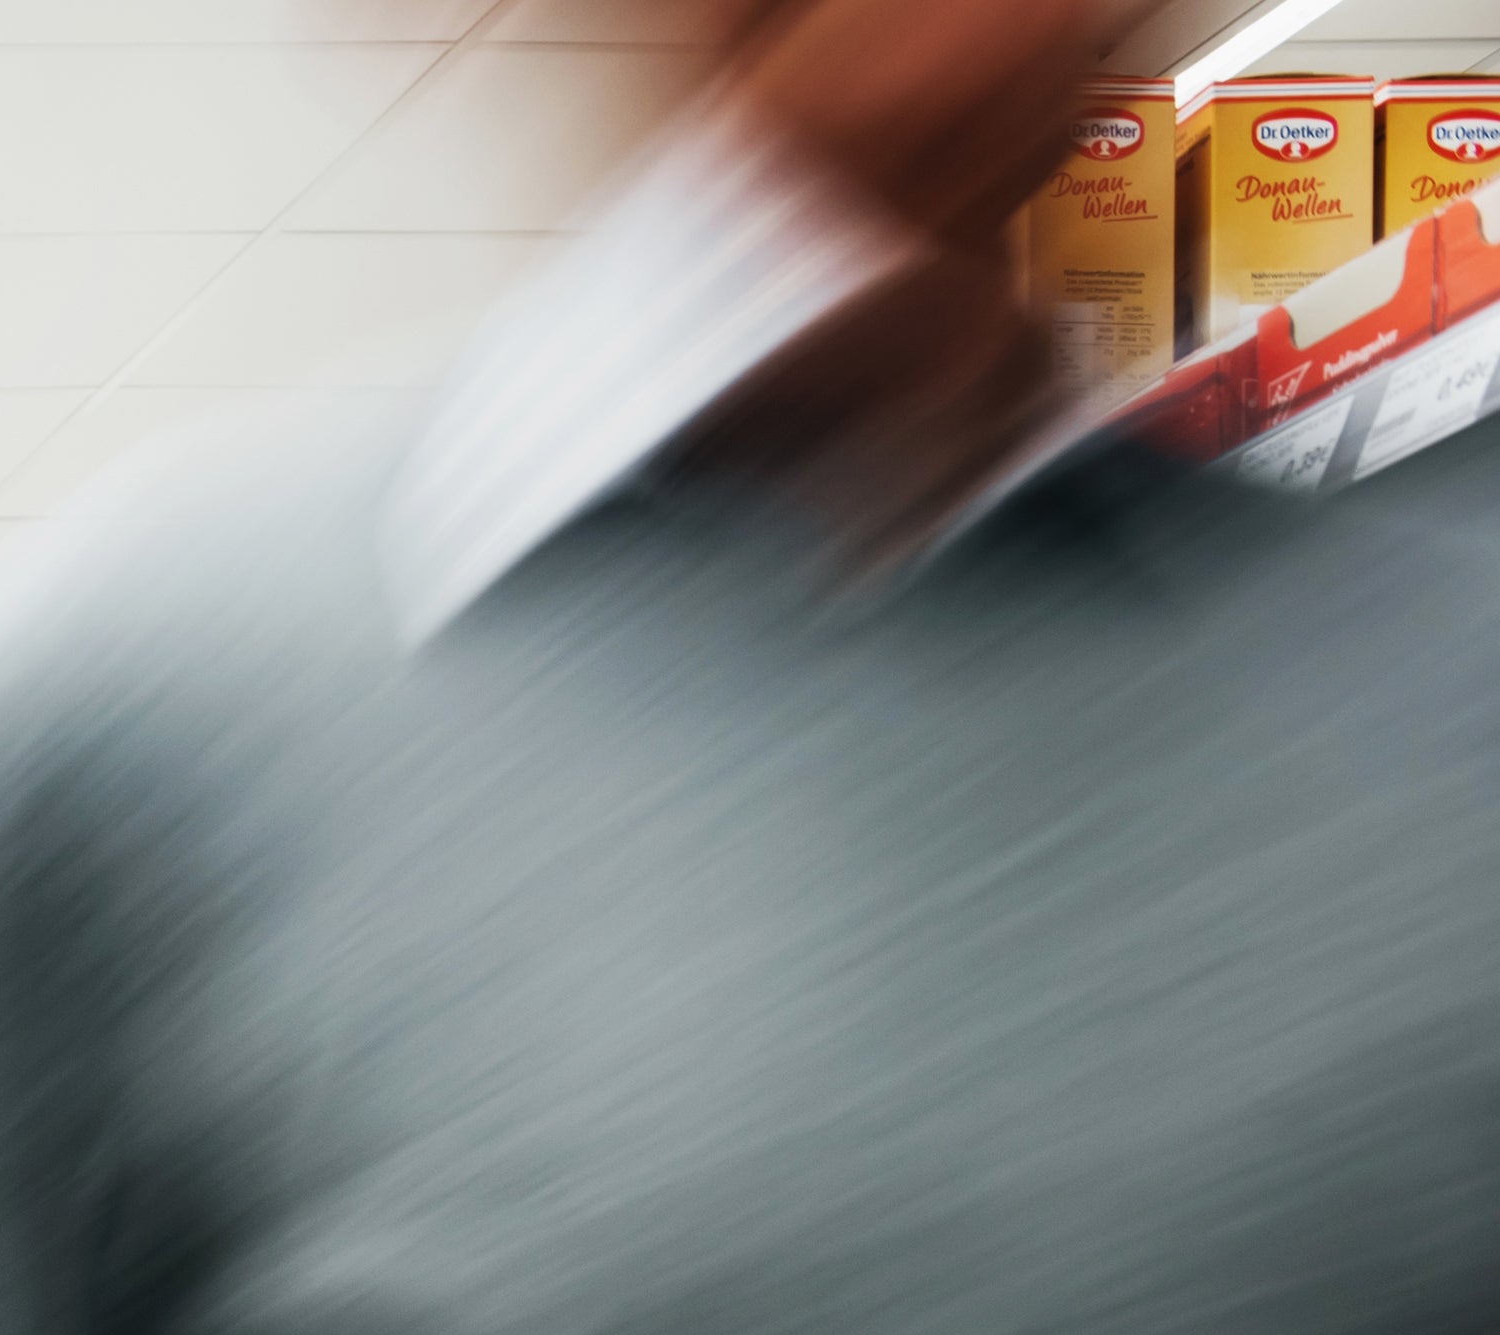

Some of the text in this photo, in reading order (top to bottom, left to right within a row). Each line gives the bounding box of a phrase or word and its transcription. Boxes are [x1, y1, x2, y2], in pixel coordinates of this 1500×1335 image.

[1090, 122, 1139, 141] Oetker
[1280, 122, 1330, 141] Oetker
[1455, 124, 1500, 142] Oetke
[1052, 172, 1133, 198] Donau-
[1236, 175, 1325, 203] Donau-
[1083, 197, 1148, 220] Wellen
[1272, 196, 1342, 222] Wellen
